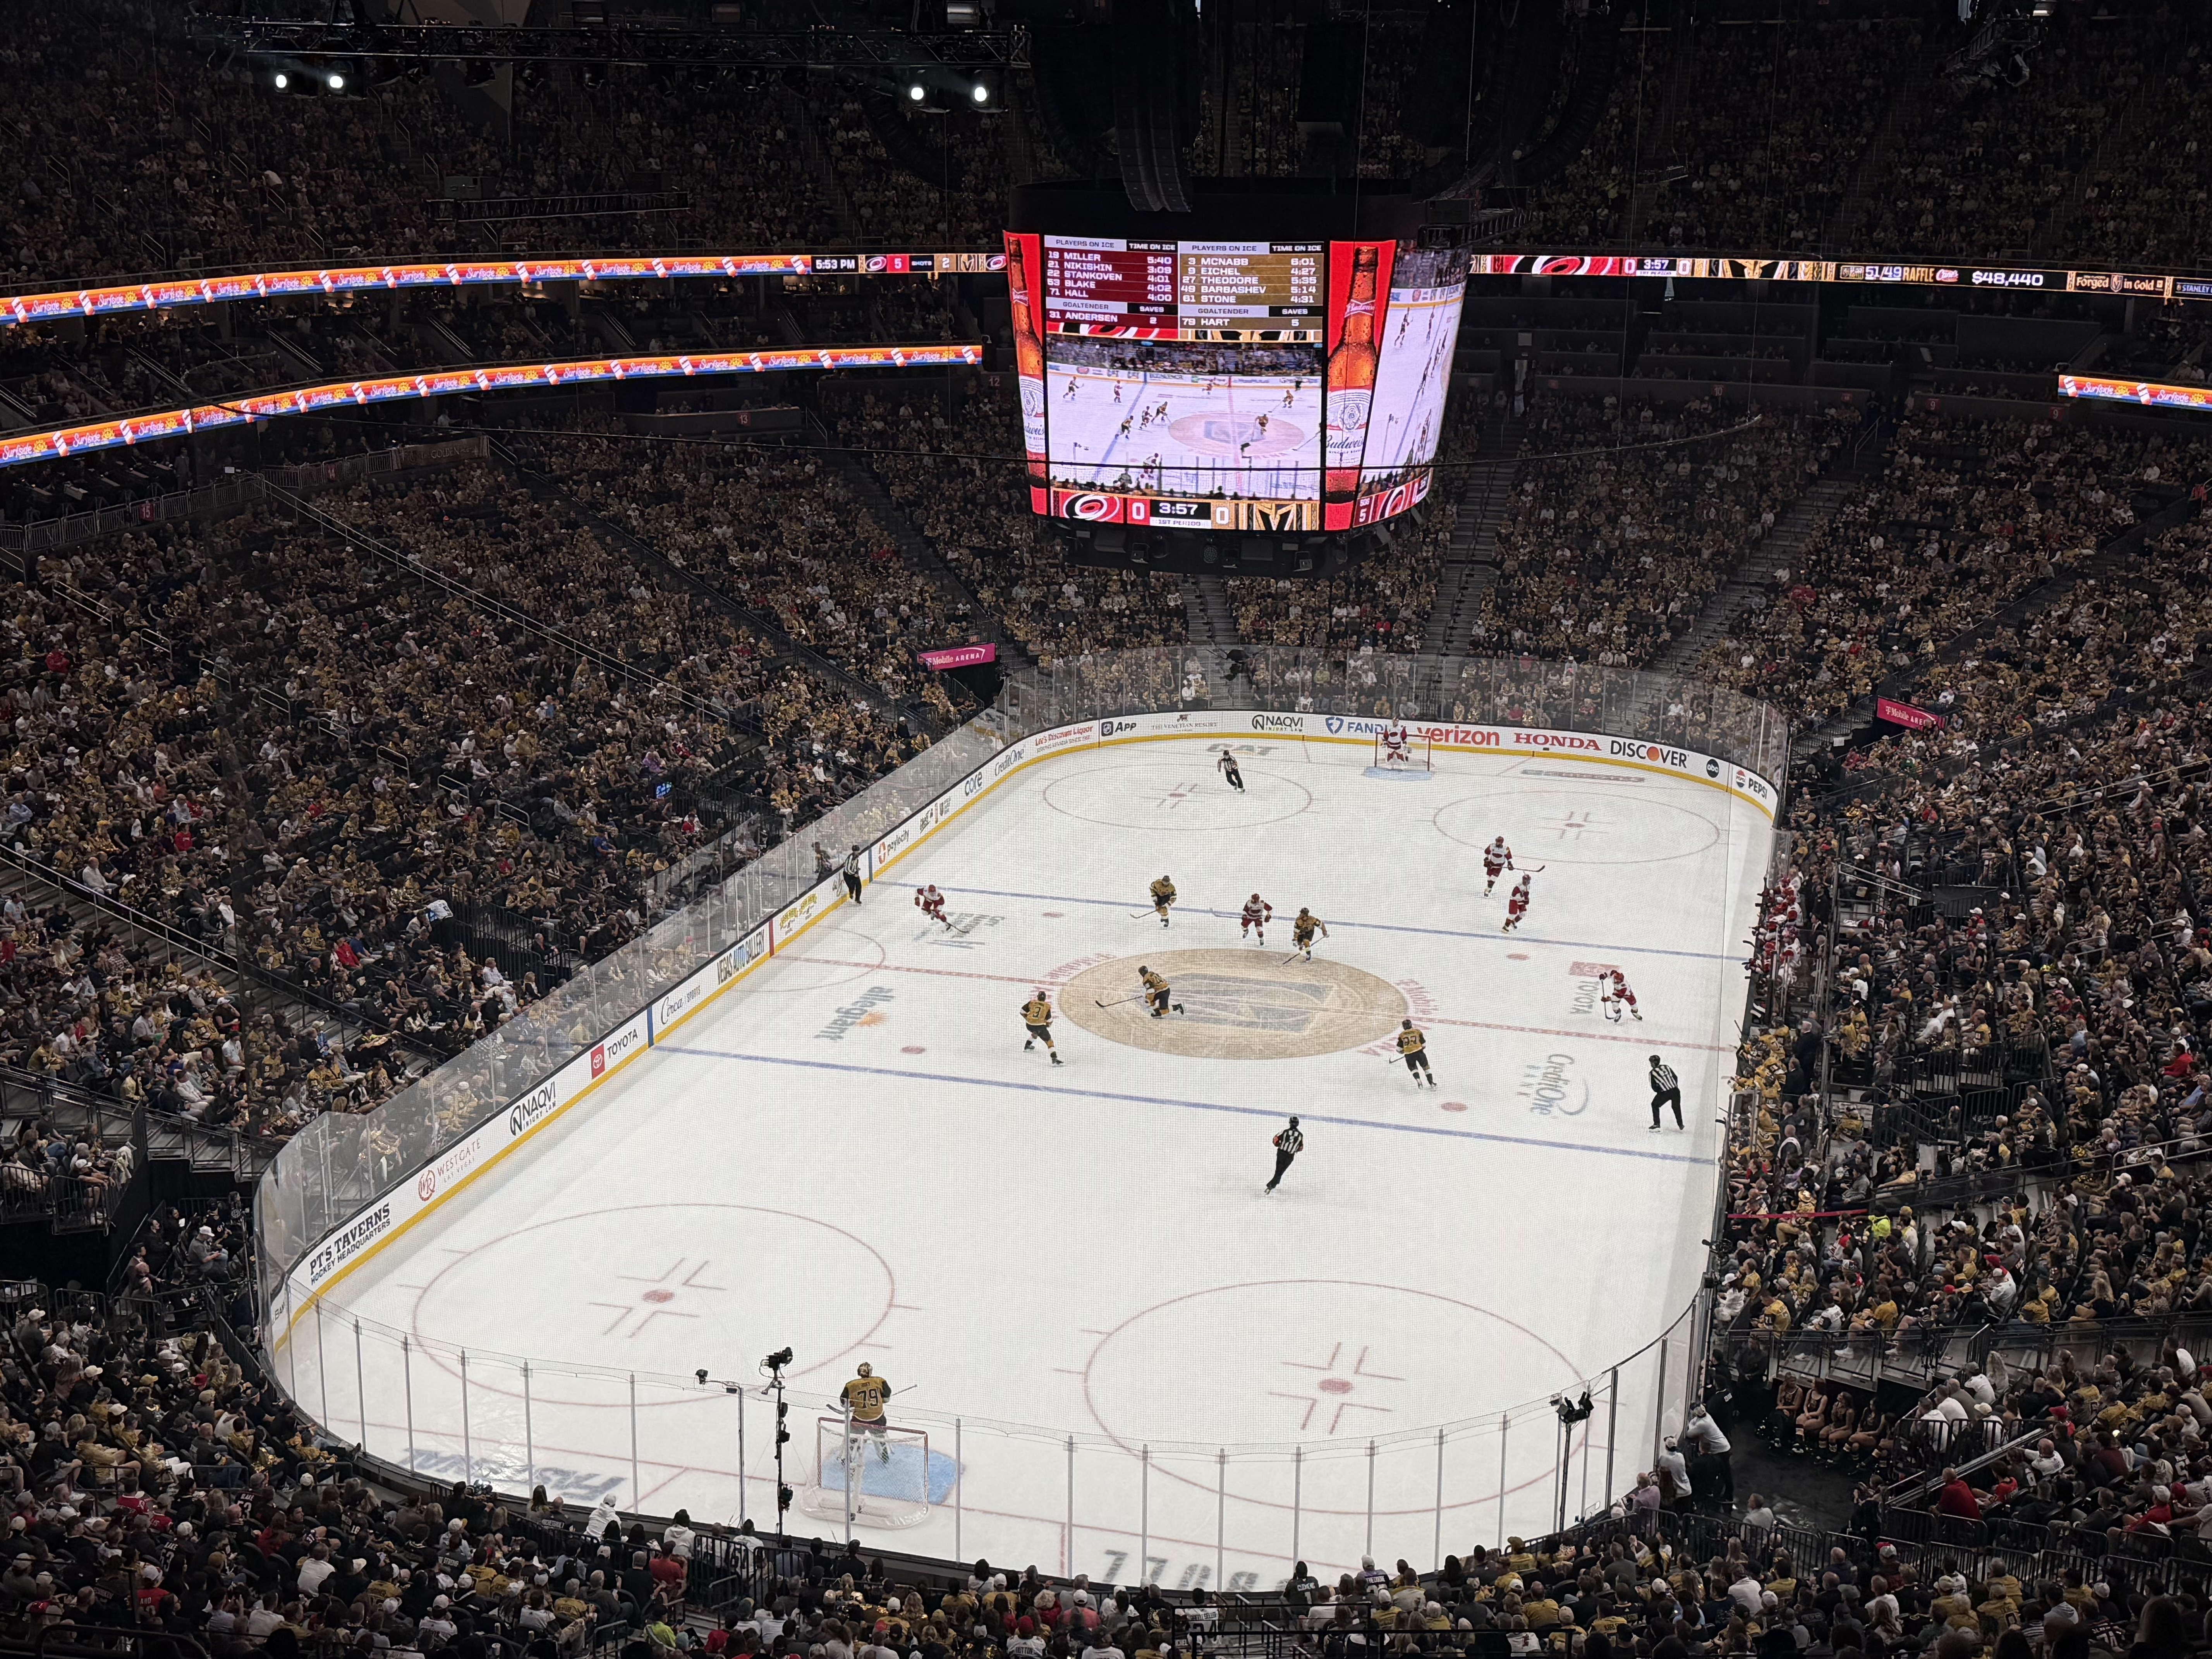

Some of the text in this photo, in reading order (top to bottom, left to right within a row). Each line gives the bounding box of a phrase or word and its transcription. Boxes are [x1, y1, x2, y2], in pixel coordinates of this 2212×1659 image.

[816, 259, 855, 269] 5:53 PM
[894, 258, 902, 269] 5
[942, 257, 950, 268] 2
[1064, 252, 1101, 261] MILLER
[1147, 256, 1172, 264] 5:40
[1201, 258, 1249, 266] MCNABB
[600, 263, 630, 274] Surfside
[672, 261, 701, 272] Surfside
[1064, 262, 1112, 271] NIKISHIN
[1624, 259, 1635, 274] 0
[1644, 259, 1669, 270] 3:57
[1678, 260, 1690, 275] 0
[466, 267, 496, 278] Surfside
[1064, 271, 1122, 281] STANKOVEN
[1865, 266, 1902, 279] 51/49
[1903, 267, 1935, 282] RAFFLE
[1972, 271, 2044, 286] $48,440
[337, 273, 364, 285] Surfside
[1065, 280, 1096, 289] BLAKE
[2076, 276, 2154, 290] Forged in Gold
[217, 282, 240, 295] Surfside
[1065, 289, 1089, 297] HALL
[1201, 285, 1266, 294] BARBASHEV
[2182, 284, 2209, 293] STANLEY
[98, 294, 124, 307] Surfside
[1063, 302, 1109, 310] GOALTENDER
[1065, 312, 1118, 322] ANDERSEN
[768, 355, 797, 366] Surfside
[910, 351, 940, 361] Surfside
[629, 362, 658, 373] Surfside
[495, 372, 524, 383] Surfside
[989, 377, 1000, 386] 12
[1714, 387, 1723, 396] 10
[2083, 382, 2114, 394] Surfside
[310, 392, 333, 404] Surfside
[1930, 401, 1936, 410] 9
[199, 411, 224, 424] Surfside
[739, 414, 748, 424] 13
[2053, 409, 2058, 419] 9
[73, 432, 101, 447] Surfside
[2, 443, 32, 460] Surfside
[1132, 502, 1145, 520] 0
[1159, 502, 1198, 515] 3:57
[1216, 507, 1229, 524] 0
[1359, 508, 1367, 522] 5
[955, 652, 980, 662] ARENA
[1266, 715, 1303, 728] NAQVI
[1417, 725, 1500, 746] verizon
[1514, 733, 1602, 751] HONDA
[1611, 740, 1687, 768] DISCOVER
[1707, 764, 1719, 773] abc
[965, 771, 982, 797] core
[1748, 777, 1768, 800] PEPSI
[887, 830, 910, 856] paylocity
[717, 929, 765, 985] VEGAS AUTO GALLERY
[661, 996, 683, 1024] Circa
[1032, 1006, 1041, 1018] 3
[607, 1029, 637, 1058] TOYOTA
[522, 1081, 556, 1121] NAQVI
[437, 1138, 480, 1177] WESTGATE
[310, 1202, 390, 1276] PT'S TAVERNS
[311, 1218, 390, 1285] HOCKEY HEADQUARTERS
[857, 1388, 878, 1409] 79
